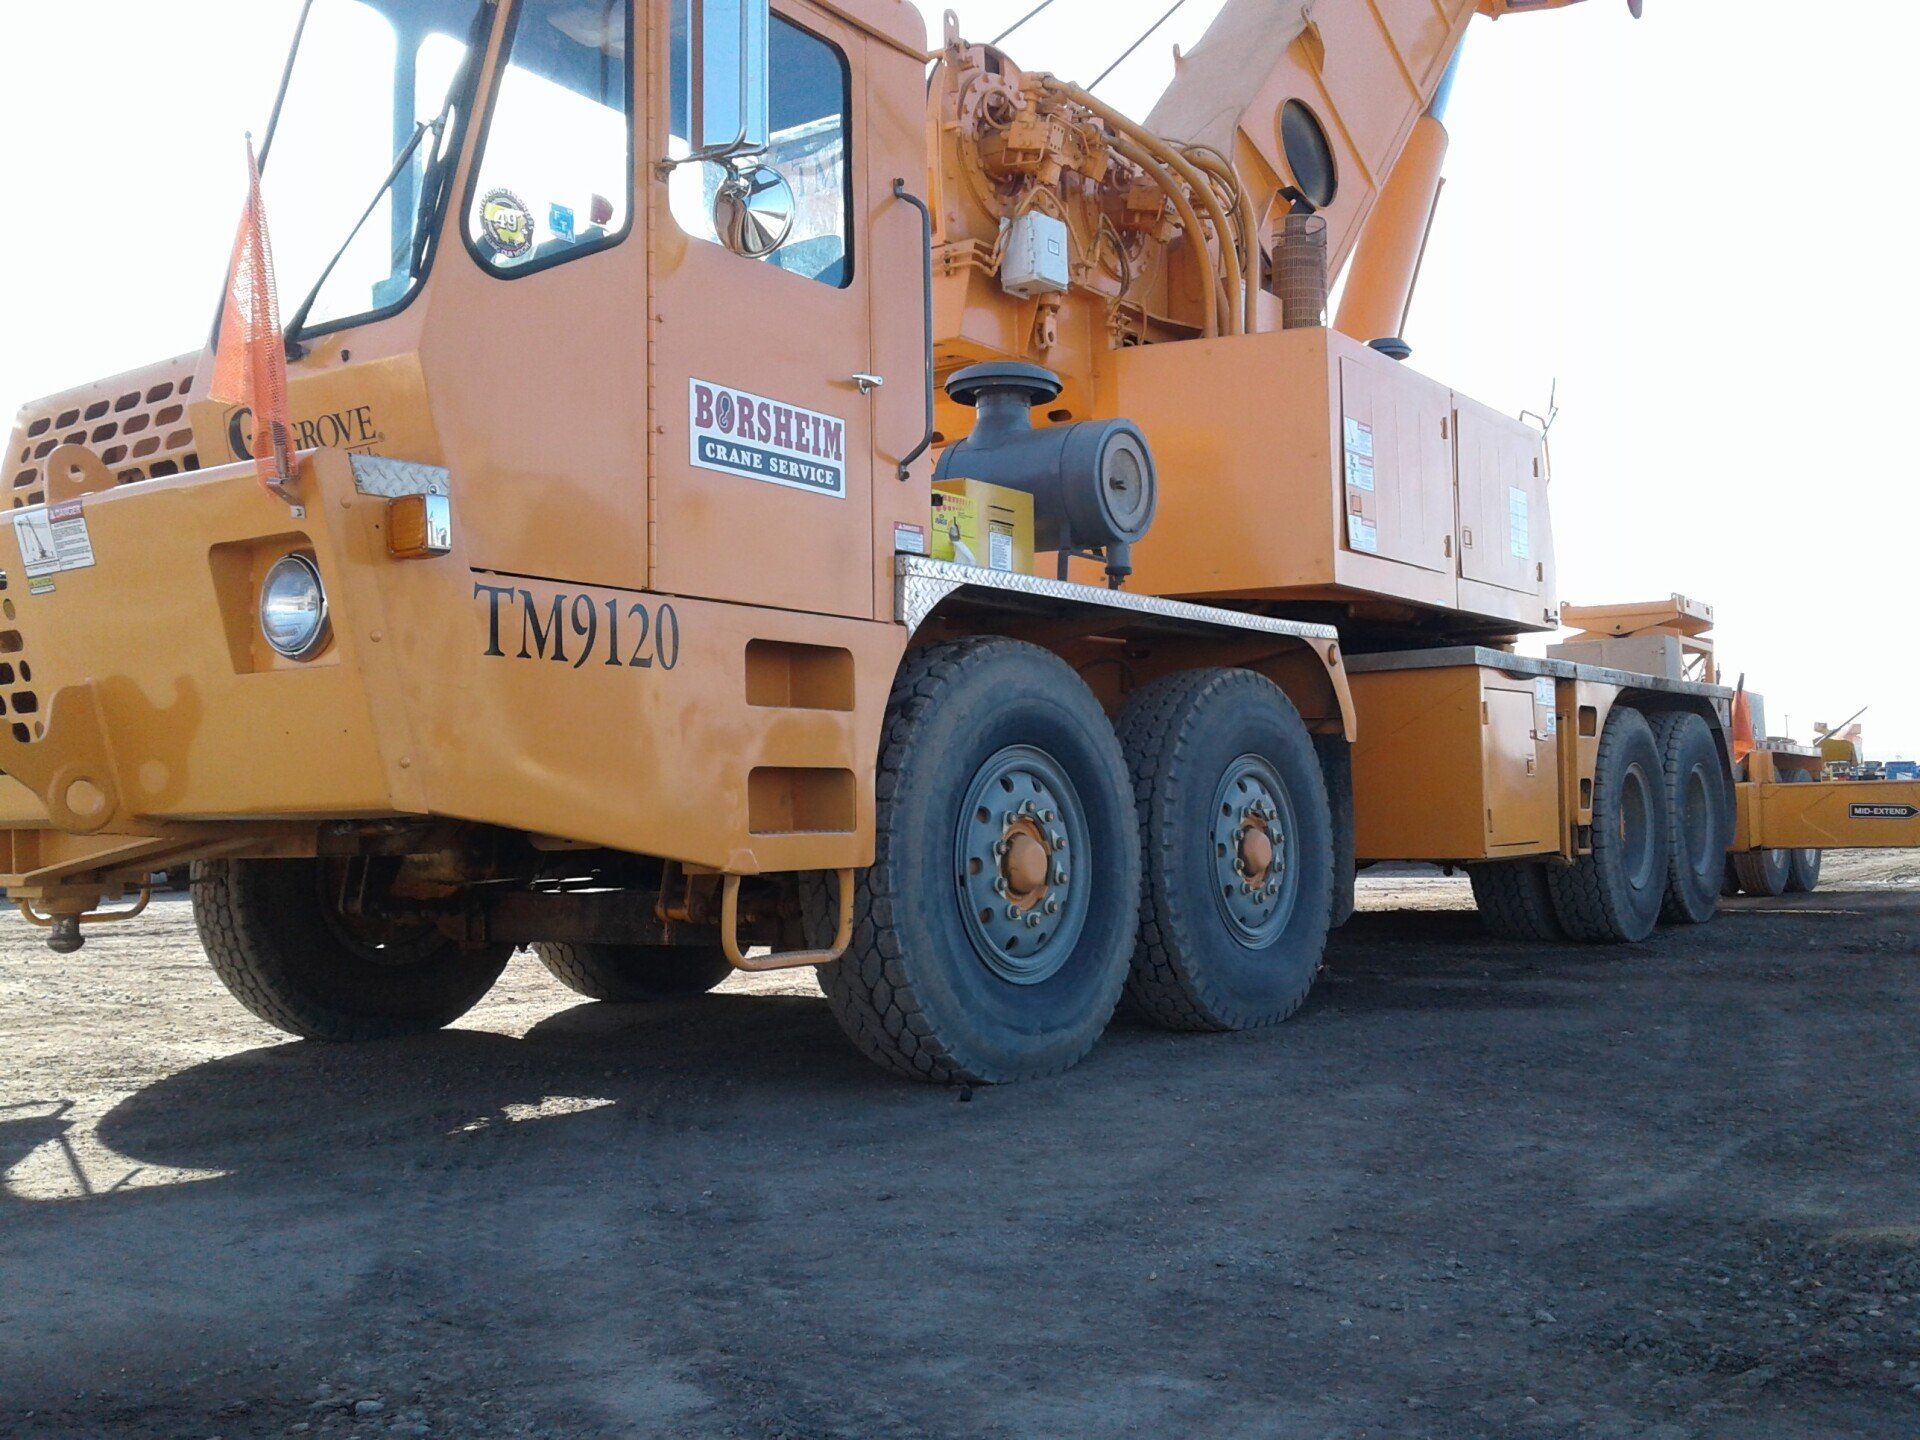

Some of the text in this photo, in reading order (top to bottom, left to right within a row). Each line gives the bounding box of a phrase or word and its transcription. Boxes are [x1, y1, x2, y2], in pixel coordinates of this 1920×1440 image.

[493, 211, 518, 233] 49
[695, 384, 842, 461] BORSHEIM
[705, 443, 834, 485] CRANE SERVICE
[473, 582, 679, 670] TM9120
[1854, 807, 1908, 815] MID-EXTEND
